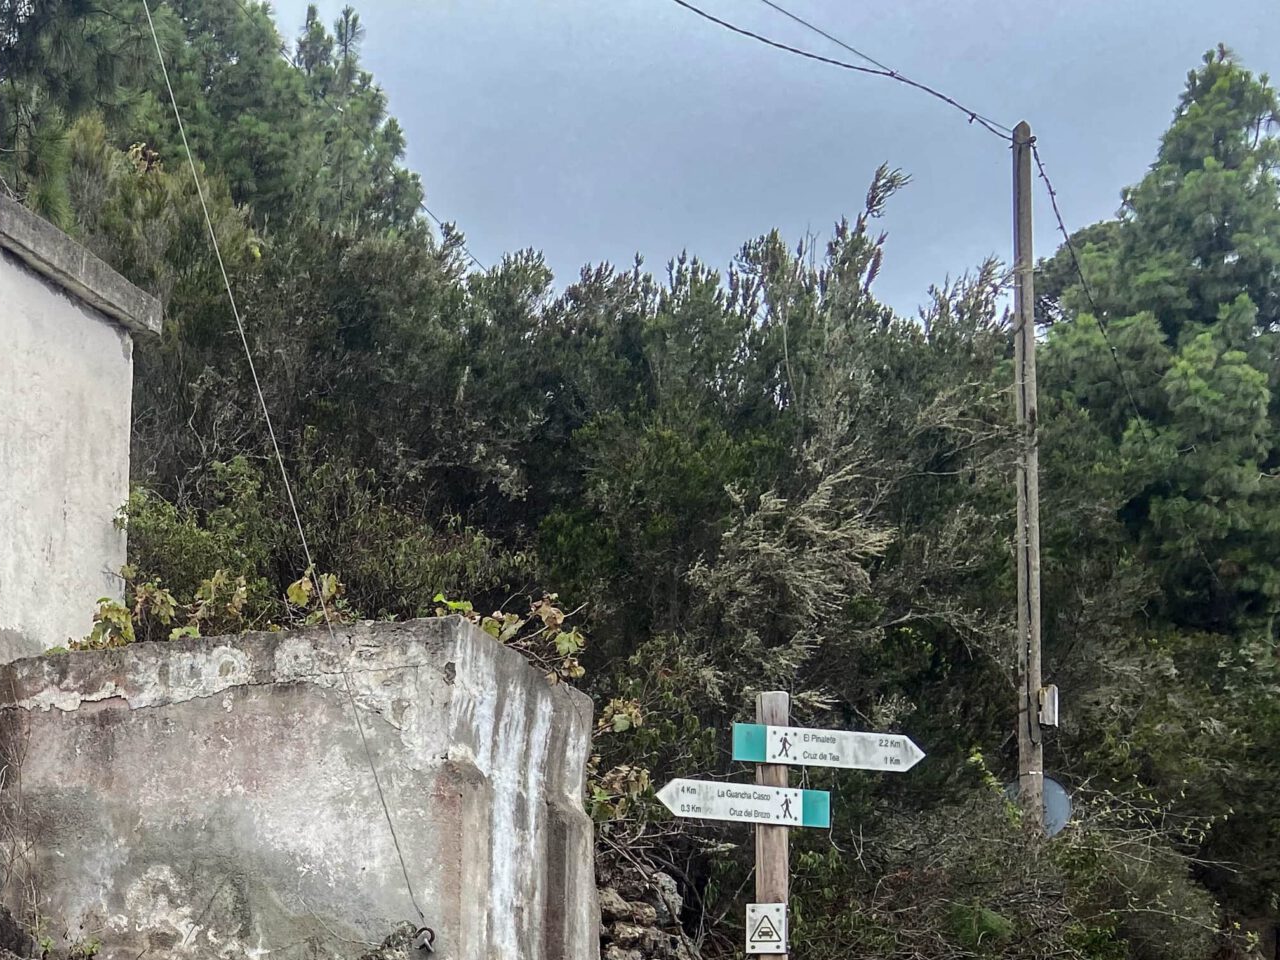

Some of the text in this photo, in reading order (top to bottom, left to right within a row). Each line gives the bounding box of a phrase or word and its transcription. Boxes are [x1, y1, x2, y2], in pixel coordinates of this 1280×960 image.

[804, 734, 810, 742] El
[811, 735, 836, 744] Pinalete
[879, 739, 889, 747] 2.2
[803, 751, 817, 760] Cruz
[829, 754, 840, 762] Tea
[686, 787, 696, 795] Km
[718, 790, 725, 798] La
[726, 790, 752, 800] Guancha
[753, 792, 770, 800] Casco
[681, 804, 690, 812] 0.3
[730, 808, 743, 817] Cruz
[744, 809, 753, 817] del
